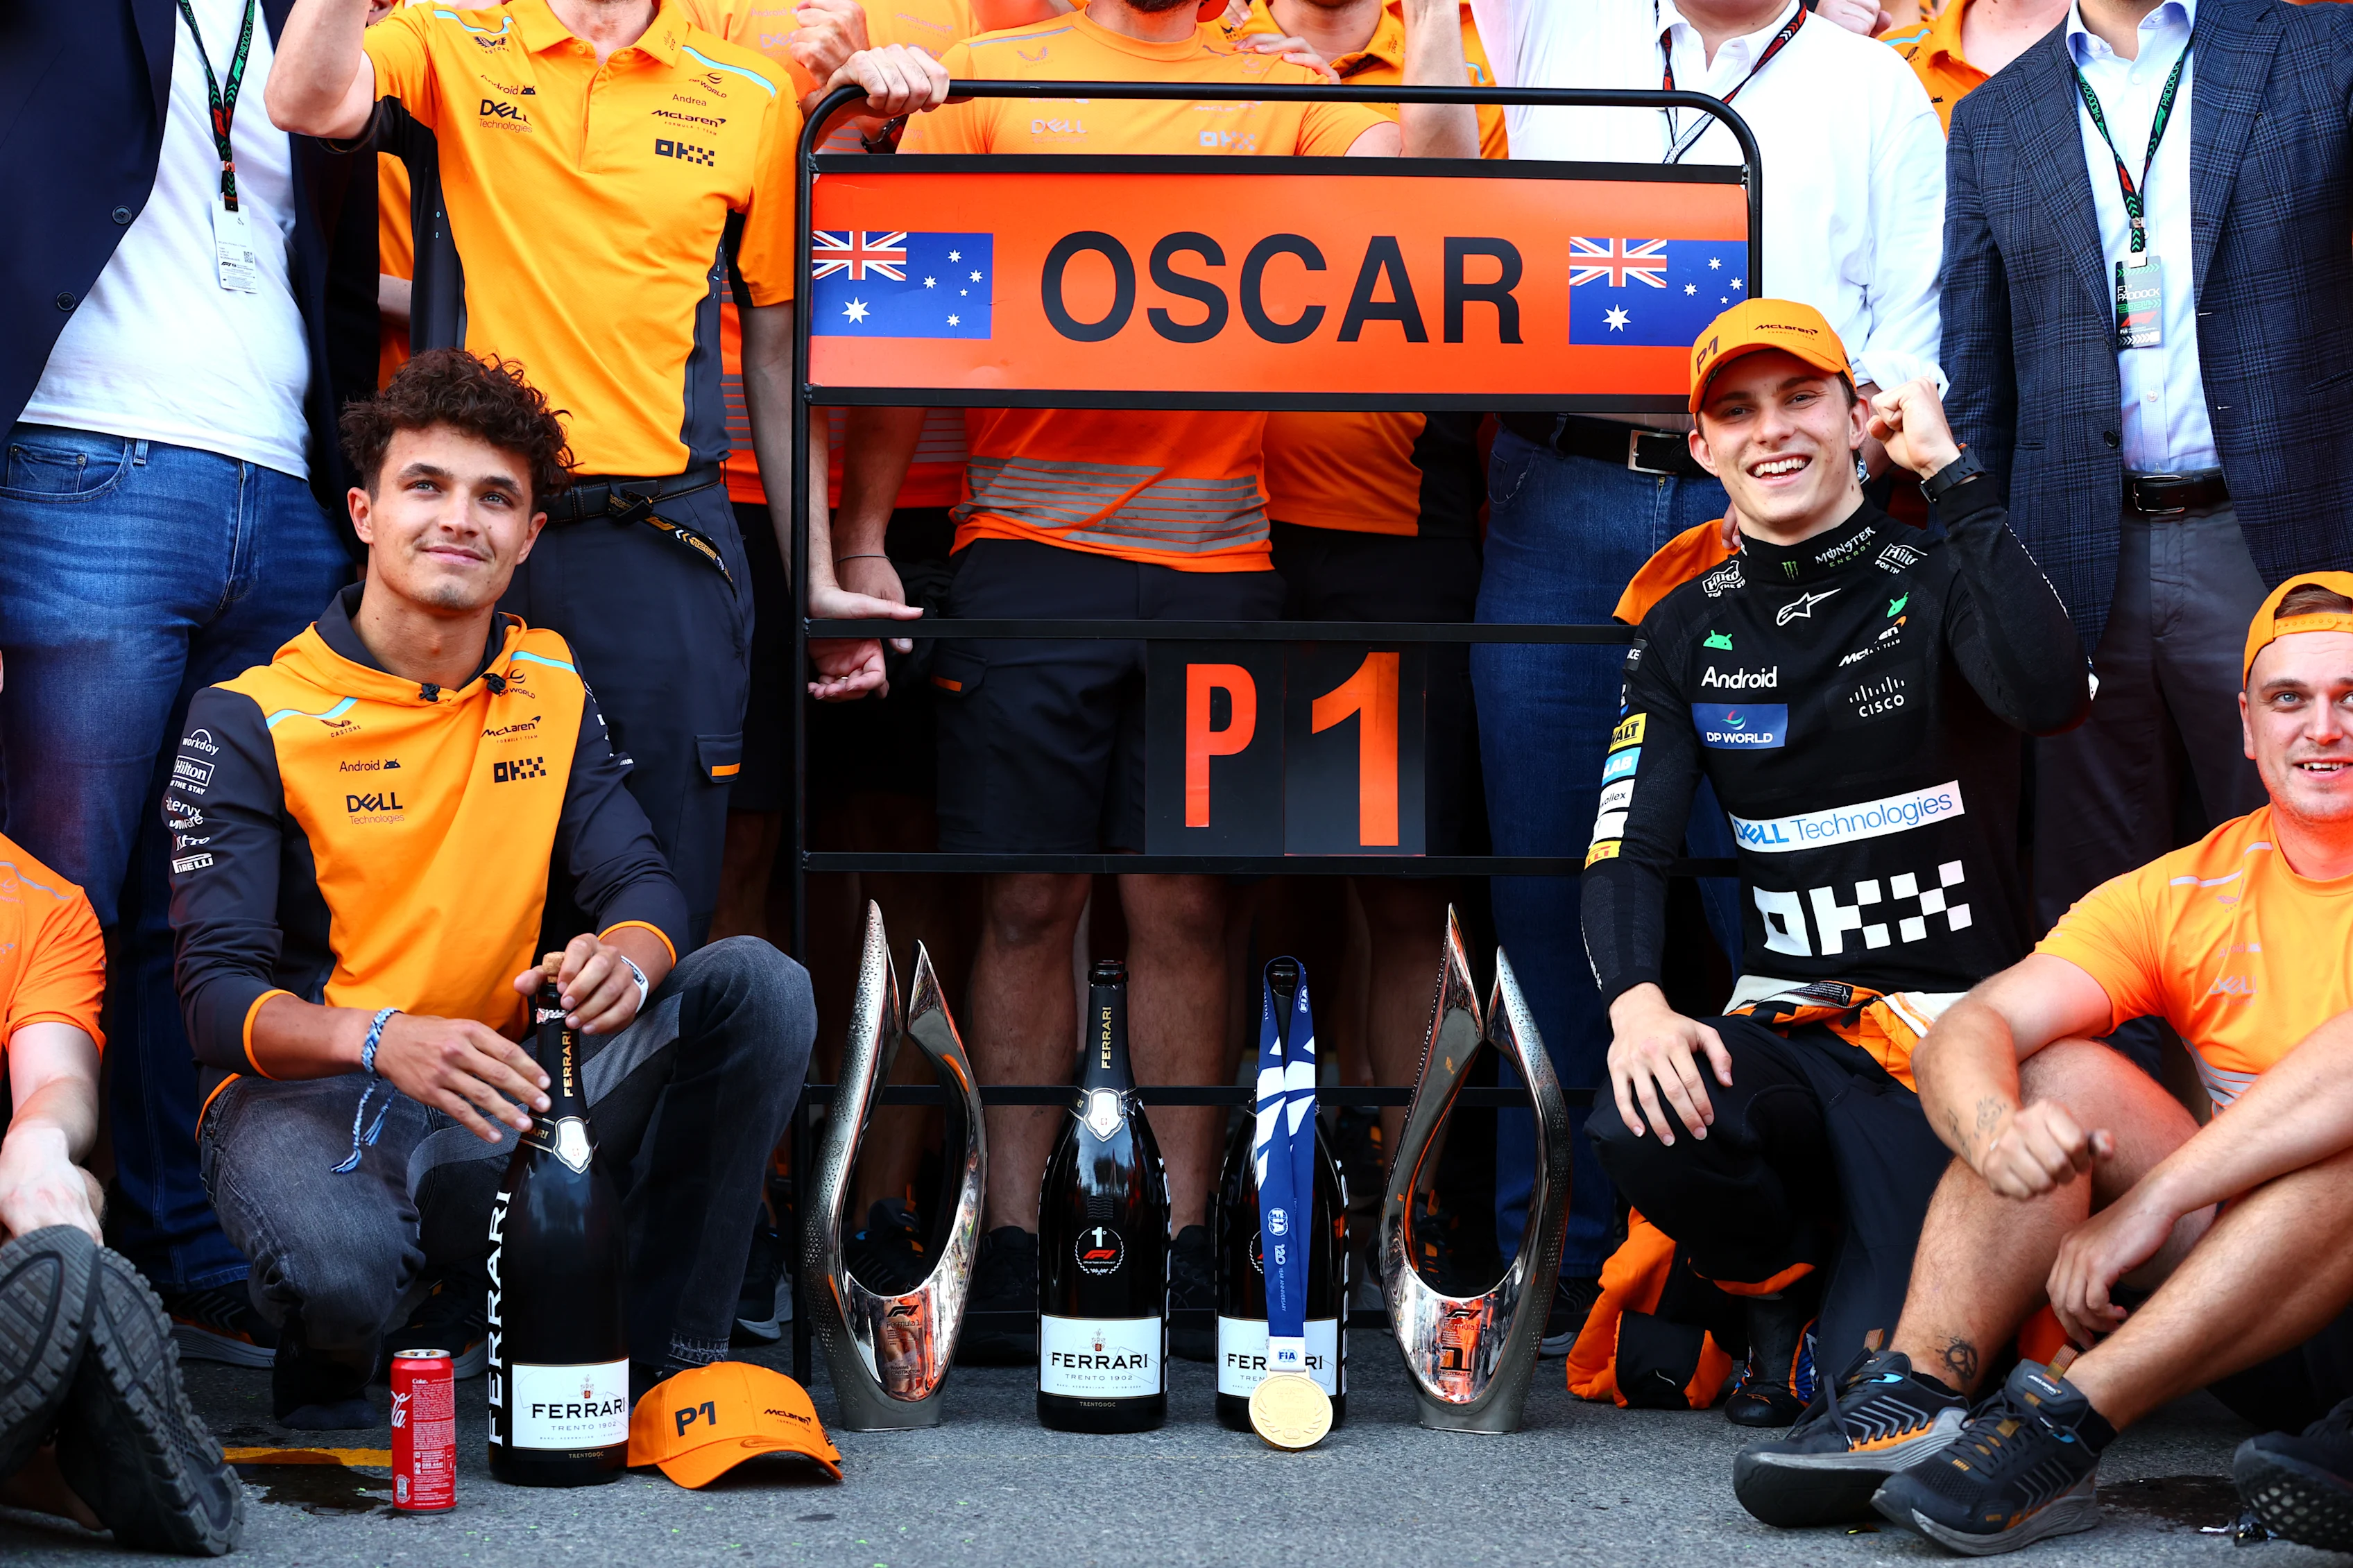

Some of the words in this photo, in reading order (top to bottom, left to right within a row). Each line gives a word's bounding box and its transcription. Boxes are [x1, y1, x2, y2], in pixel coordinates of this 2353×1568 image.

[751, 8, 787, 17] Android
[238, 21, 252, 58] PADDOCK
[760, 32, 794, 48] DE
[481, 74, 519, 95] Android
[701, 80, 727, 98] WORLD
[2161, 63, 2181, 107] PADDOCK
[672, 94, 707, 107] Andrea
[2082, 84, 2100, 121] PADDOCK
[479, 98, 532, 126] DELL
[651, 110, 727, 128] McLaren
[479, 118, 533, 133] Technologies
[665, 121, 694, 129] FORMULA
[703, 128, 717, 136] TEAM
[1031, 118, 1087, 135] DELL
[1686, 116, 1711, 139] ACCESS
[1199, 130, 1256, 151] OKX
[655, 138, 715, 167] OKX
[1041, 230, 1524, 344] OSCAR
[2117, 287, 2160, 302] PADDOCK
[1754, 324, 1818, 336] McLaren
[1696, 335, 1719, 375] P1
[1815, 526, 1876, 565] MONSTER
[1829, 540, 1872, 568] ENERGY
[1885, 546, 1919, 566] Hilt
[1874, 559, 1890, 571] FOR
[1890, 565, 1901, 575] TH
[1707, 571, 1739, 591] Hilto
[1883, 638, 1901, 649] TEAM
[1701, 666, 1777, 689] Android
[509, 687, 536, 699] WORLD
[1858, 694, 1905, 718] CISCO
[330, 724, 361, 738] CASTORE
[480, 715, 542, 739] McLaren
[182, 736, 220, 756] workday
[1706, 732, 1723, 743] DP
[1723, 732, 1773, 744] WORLD
[173, 760, 208, 782] Hilton
[339, 759, 380, 772] Android
[493, 757, 547, 783] OKX
[1603, 755, 1634, 779] LAB
[174, 779, 187, 790] THE
[187, 784, 206, 795] STAY
[346, 791, 403, 813] DELL
[1600, 792, 1627, 809] wallex
[349, 813, 404, 826] Technologies
[1734, 818, 1790, 845] DELL
[1790, 791, 1953, 843] Technologies
[172, 852, 214, 875] PIRELLI
[1752, 860, 1973, 957] OKX
[1101, 1006, 1111, 1069] FERRARI
[563, 1031, 574, 1097] FERRARI
[487, 1189, 511, 1447] FERRARI
[1051, 1352, 1148, 1370] FERRARI
[1227, 1352, 1324, 1370] FERRI
[531, 1397, 625, 1419] FERRARI
[764, 1408, 812, 1426] McLaren
[599, 1421, 617, 1429] 1902
[675, 1400, 717, 1438] P1
[568, 1451, 604, 1460] TRENTODOC
